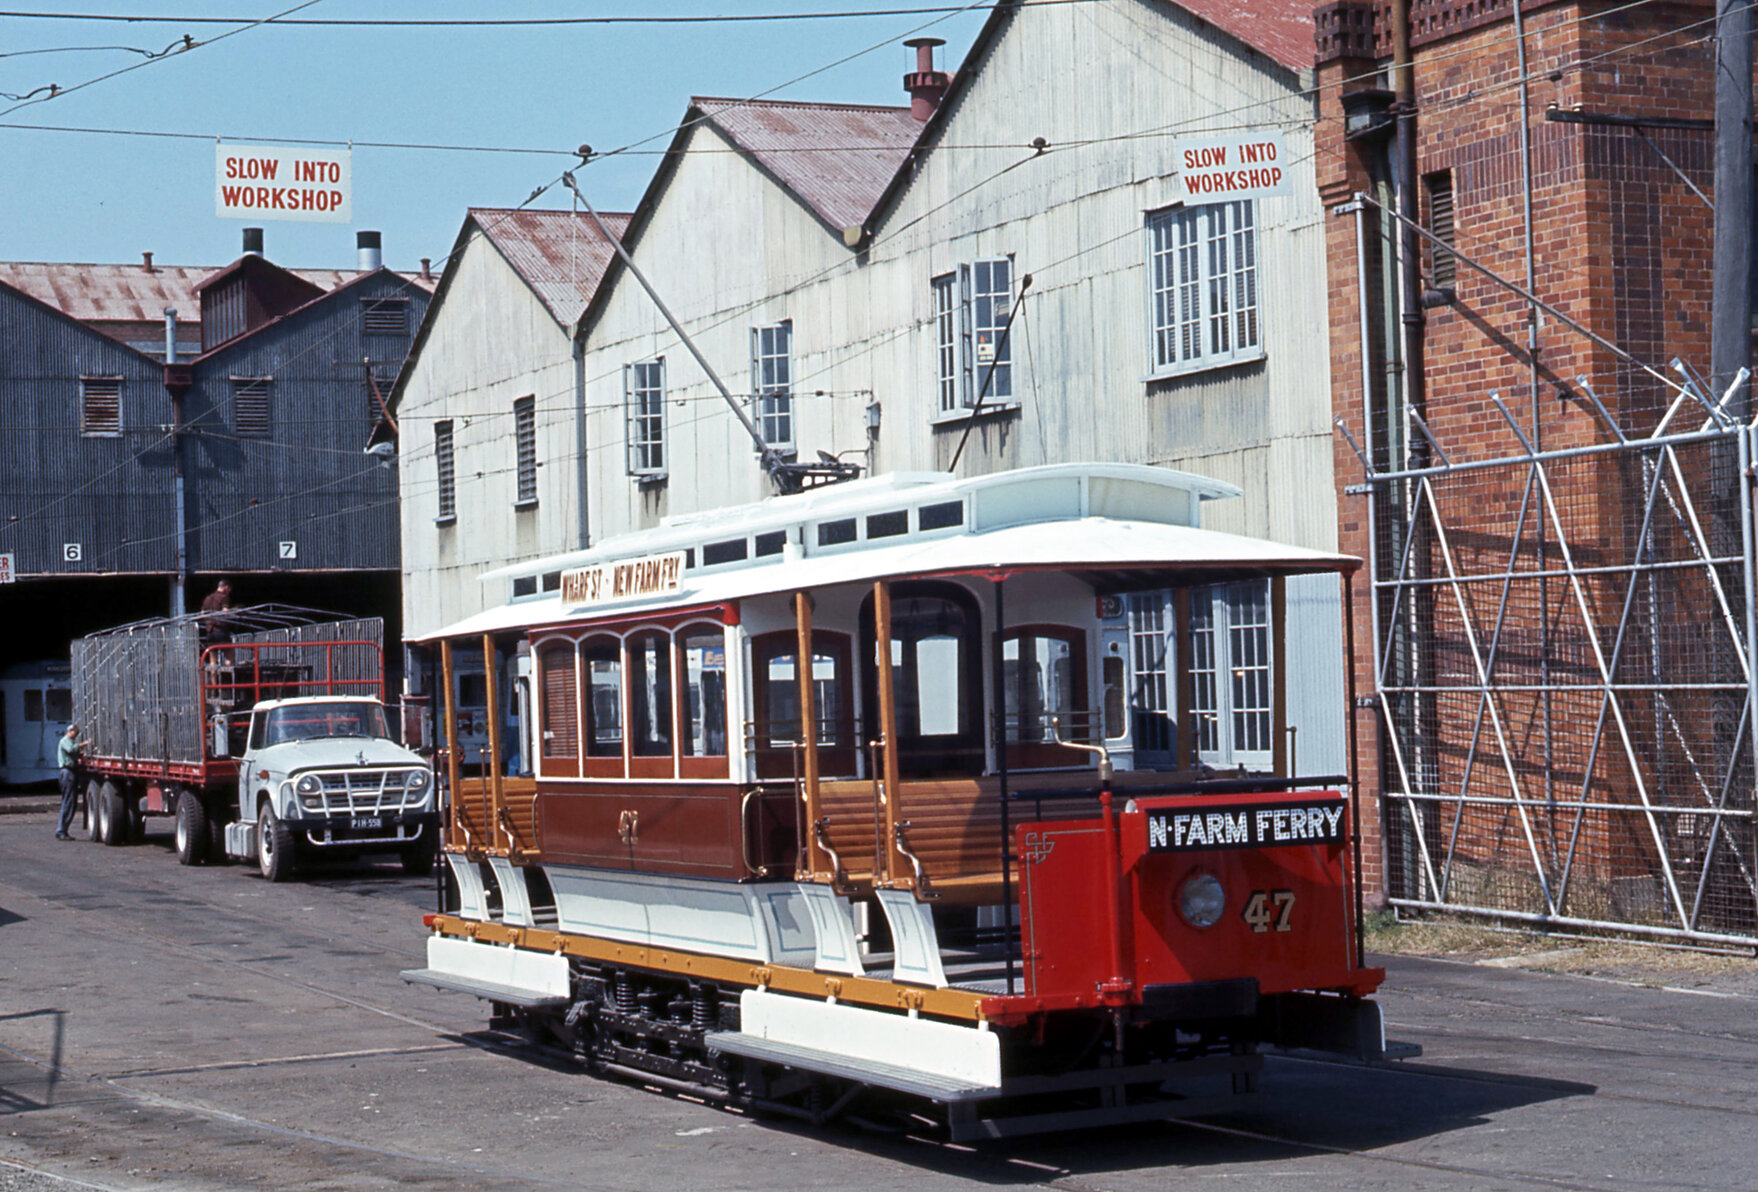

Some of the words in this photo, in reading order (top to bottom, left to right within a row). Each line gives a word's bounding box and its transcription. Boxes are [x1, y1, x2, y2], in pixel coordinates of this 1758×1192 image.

[1183, 146, 1226, 169] SLOW
[1238, 142, 1277, 164] INTO
[225, 157, 279, 180] SLOW
[294, 160, 341, 183] INTO
[1184, 167, 1282, 195] WORKSHOP
[221, 185, 343, 212] WORKSHOP
[66, 545, 79, 560] 6
[281, 543, 293, 556] 7
[561, 569, 590, 605] WHARF
[612, 562, 633, 597] NEW
[634, 559, 661, 594] FARM
[617, 810, 639, 845] 47
[1256, 806, 1344, 842] FERRY
[1242, 889, 1296, 933] 47
